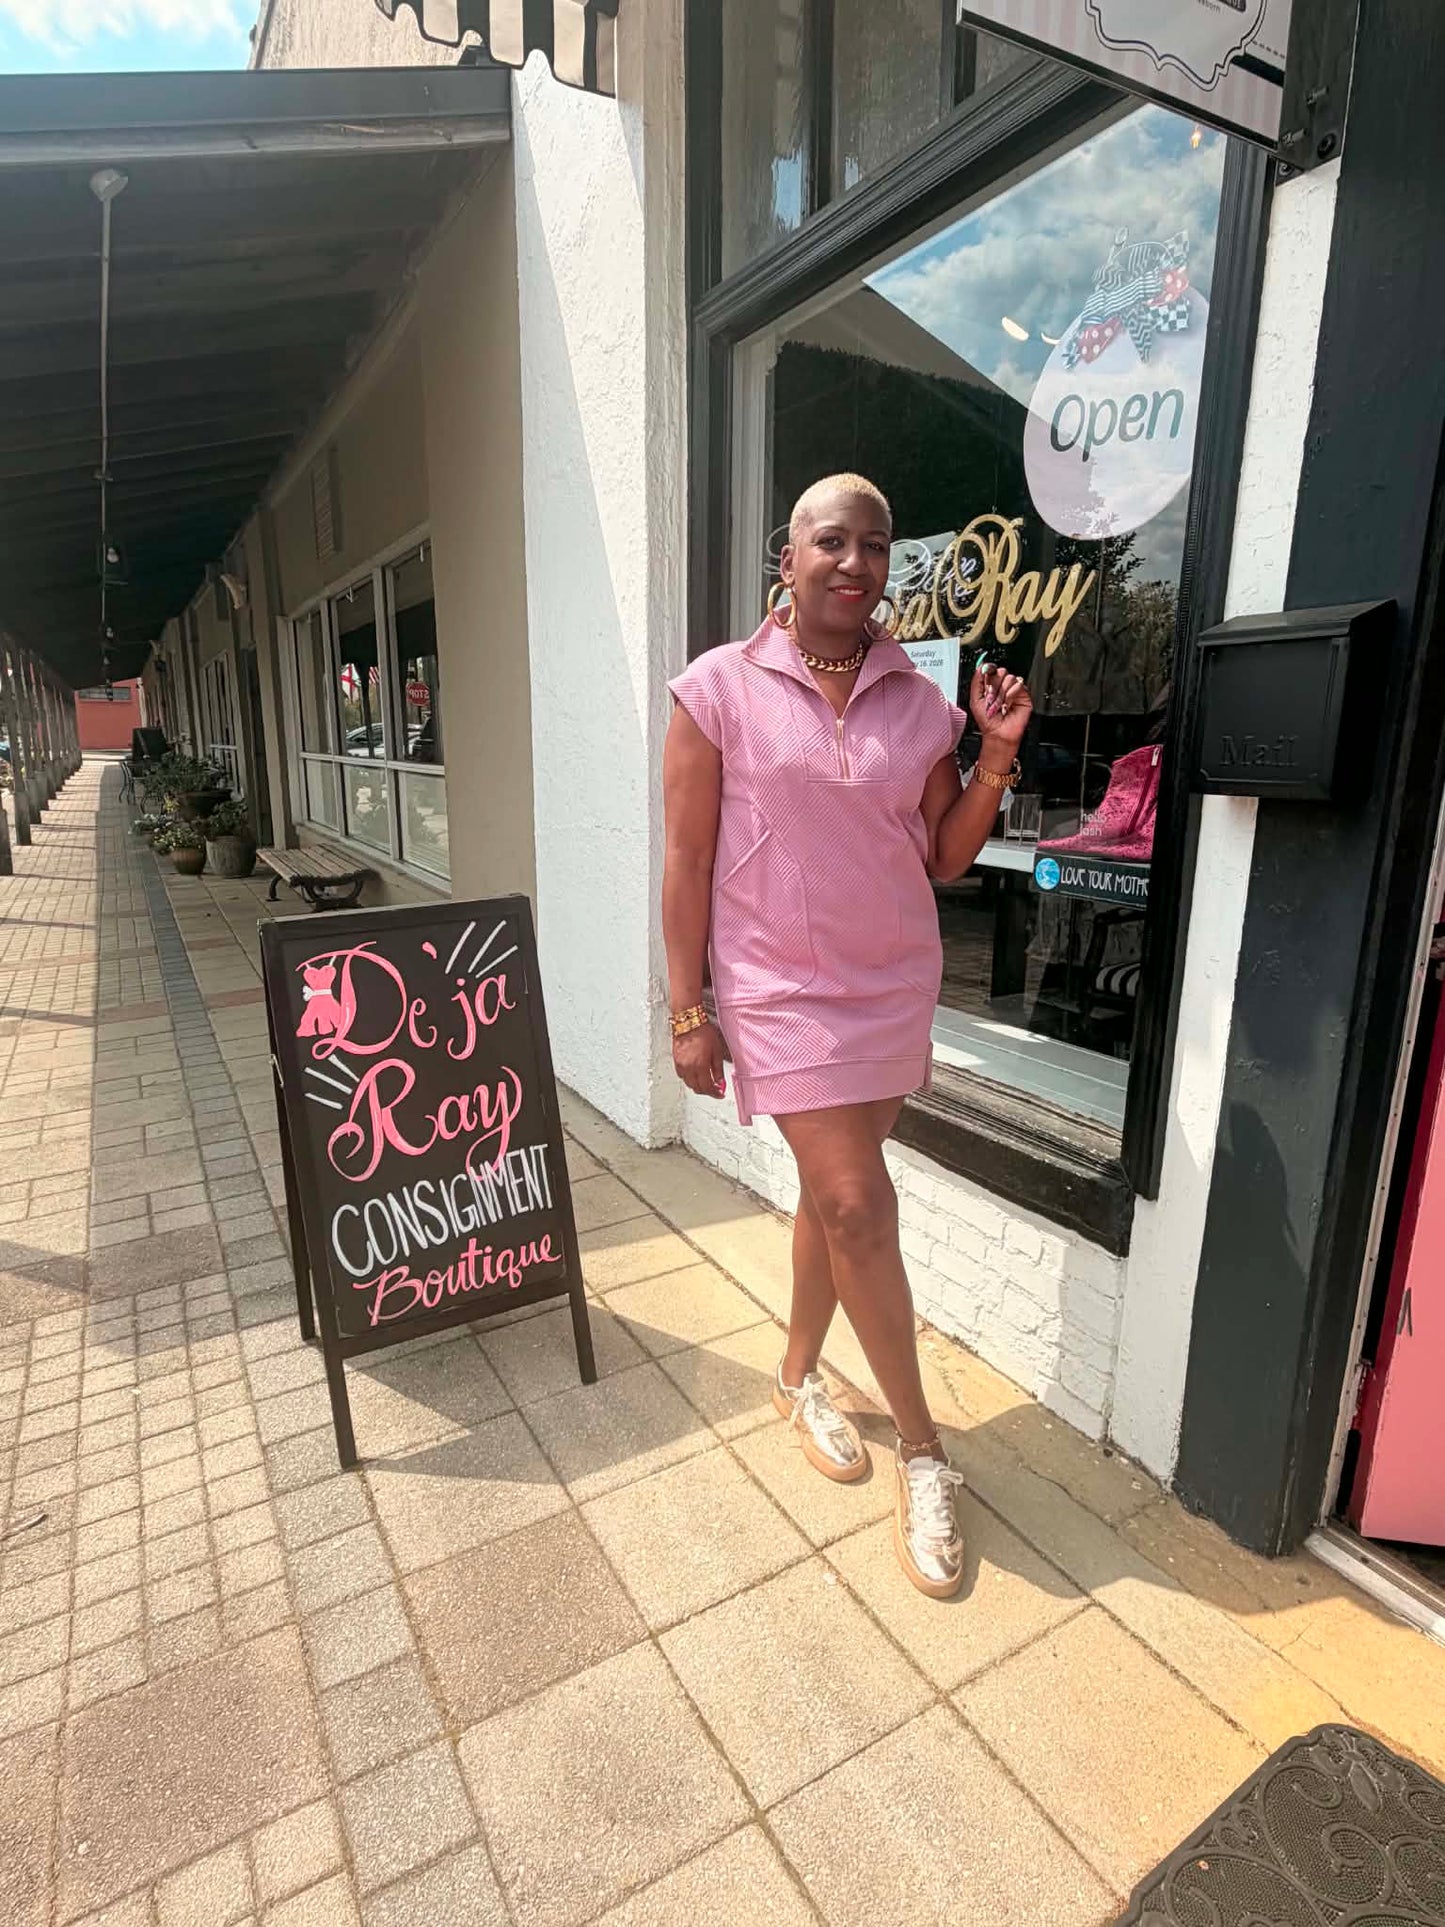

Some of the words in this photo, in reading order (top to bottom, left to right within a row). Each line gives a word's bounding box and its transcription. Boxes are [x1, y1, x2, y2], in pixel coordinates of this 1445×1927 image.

[1050, 388, 1184, 462] Open
[933, 513, 1099, 659] Ray
[1219, 734, 1298, 768] Mail
[1061, 866, 1086, 888] LOVE
[328, 1058, 524, 1183] Ray
[331, 1144, 553, 1278] CONSIGNMENT
[352, 1232, 563, 1326] Boutique
